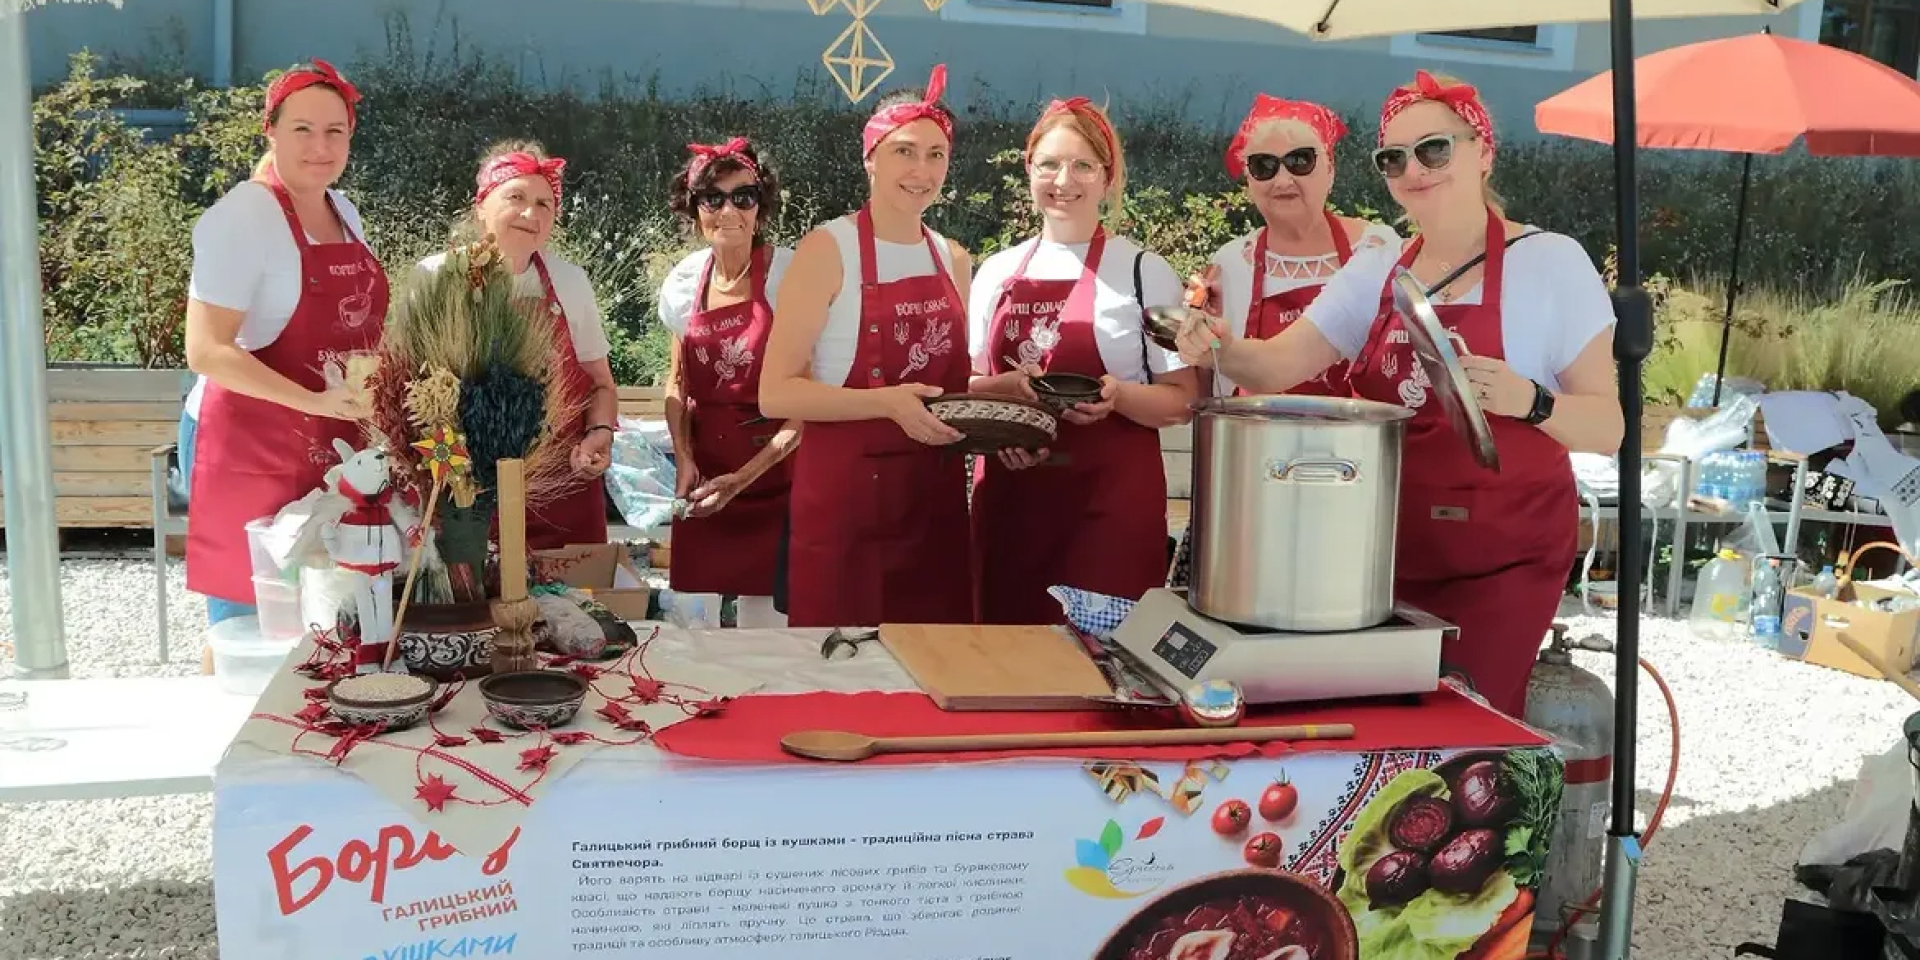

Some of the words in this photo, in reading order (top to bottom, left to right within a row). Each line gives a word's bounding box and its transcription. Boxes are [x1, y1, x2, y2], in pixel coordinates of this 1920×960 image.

[1384, 329, 1410, 344] ОРЩ
[572, 840, 652, 853] Галицький
[657, 837, 717, 851] грибний
[721, 836, 760, 849] борщ
[765, 836, 777, 847] із
[781, 836, 846, 848] вушками
[861, 831, 941, 845] традиційна
[946, 831, 982, 842] пісна
[987, 829, 1035, 841] страва
[572, 858, 664, 870] Святвечора.
[578, 874, 612, 886] Його
[620, 875, 666, 886] варять
[672, 874, 688, 884] на
[765, 869, 825, 879] сушених
[830, 867, 881, 877] лісових
[886, 865, 927, 876] грибів
[934, 865, 948, 874] та
[954, 862, 1030, 874] буряковому
[382, 879, 514, 922] ГАЛИЦЬКИЙ
[617, 893, 637, 902] що
[645, 890, 702, 901] надають
[708, 887, 752, 898] борщу
[759, 885, 836, 896] насиченого
[842, 883, 897, 893] аромату
[418, 896, 518, 932] ГРИБНИЙ
[571, 906, 655, 919] Особливість
[663, 905, 710, 916] страви
[797, 900, 838, 911] вушка
[861, 897, 910, 907] тонкого
[918, 895, 949, 904] тіста
[969, 891, 1023, 903] грибною
[652, 922, 671, 932] які
[799, 916, 817, 926] Це
[882, 913, 902, 922] що
[363, 932, 518, 960] УШКАМИ
[572, 940, 627, 952] традиції
[630, 940, 646, 949] та
[714, 933, 787, 945] атмосферу
[790, 930, 861, 941] галицького
